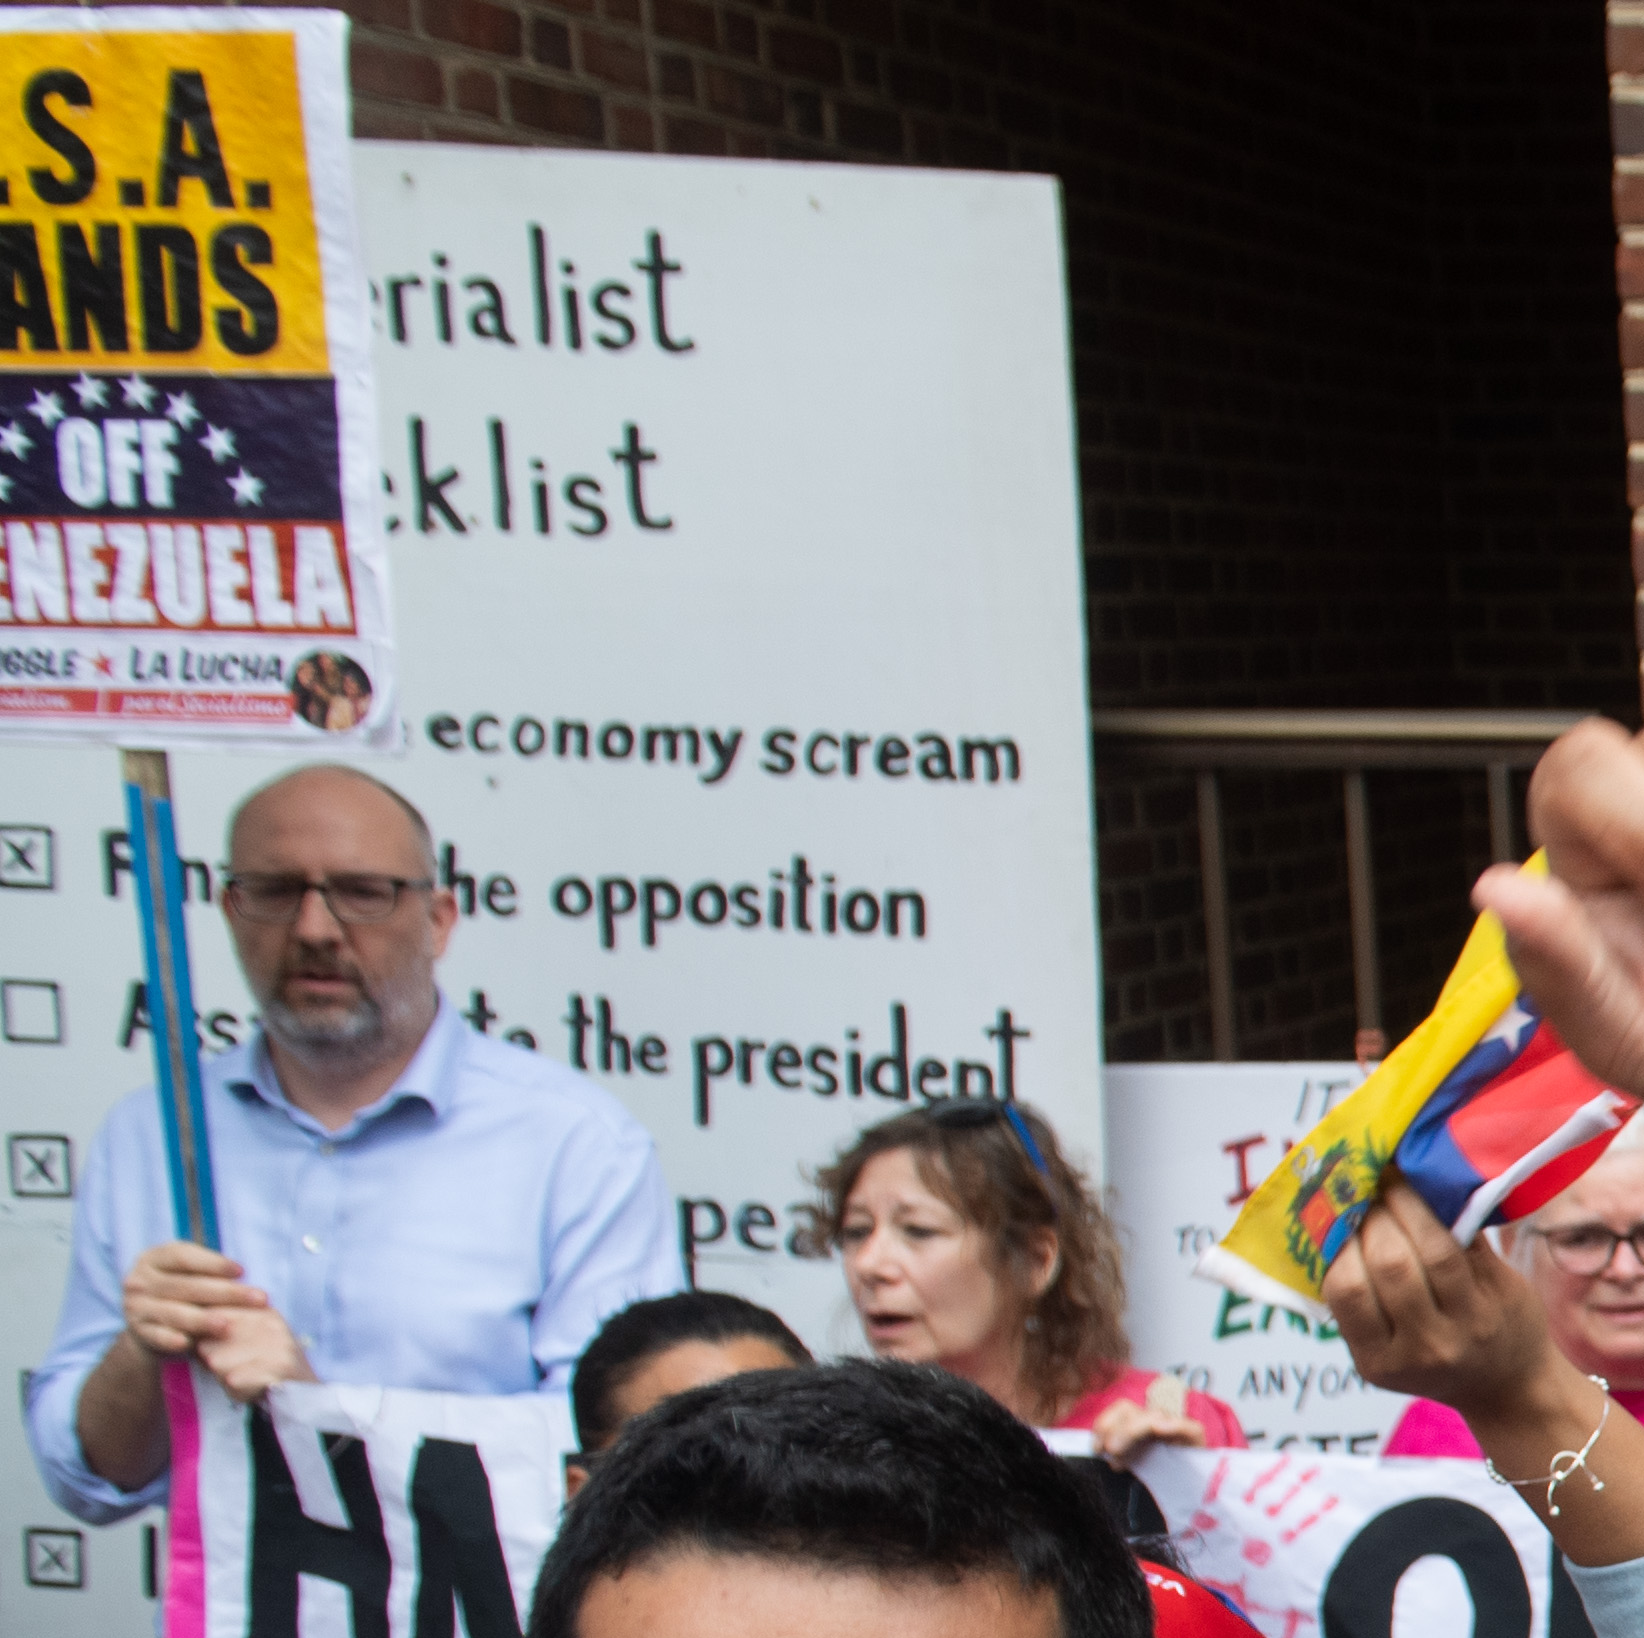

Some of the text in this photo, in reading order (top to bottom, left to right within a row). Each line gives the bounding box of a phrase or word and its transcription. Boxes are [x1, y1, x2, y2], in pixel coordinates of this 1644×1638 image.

[0, 68, 272, 209] S.A.
[370, 221, 694, 353] rialist
[56, 417, 182, 508] OFF
[383, 413, 673, 537] klist
[0, 522, 353, 630] NEZUELA
[0, 645, 285, 683] GGLE LA LUCHA
[425, 713, 1023, 784] economy scream
[438, 840, 927, 951] he opposition
[563, 991, 669, 1074] the
[691, 1000, 1031, 1127] president
